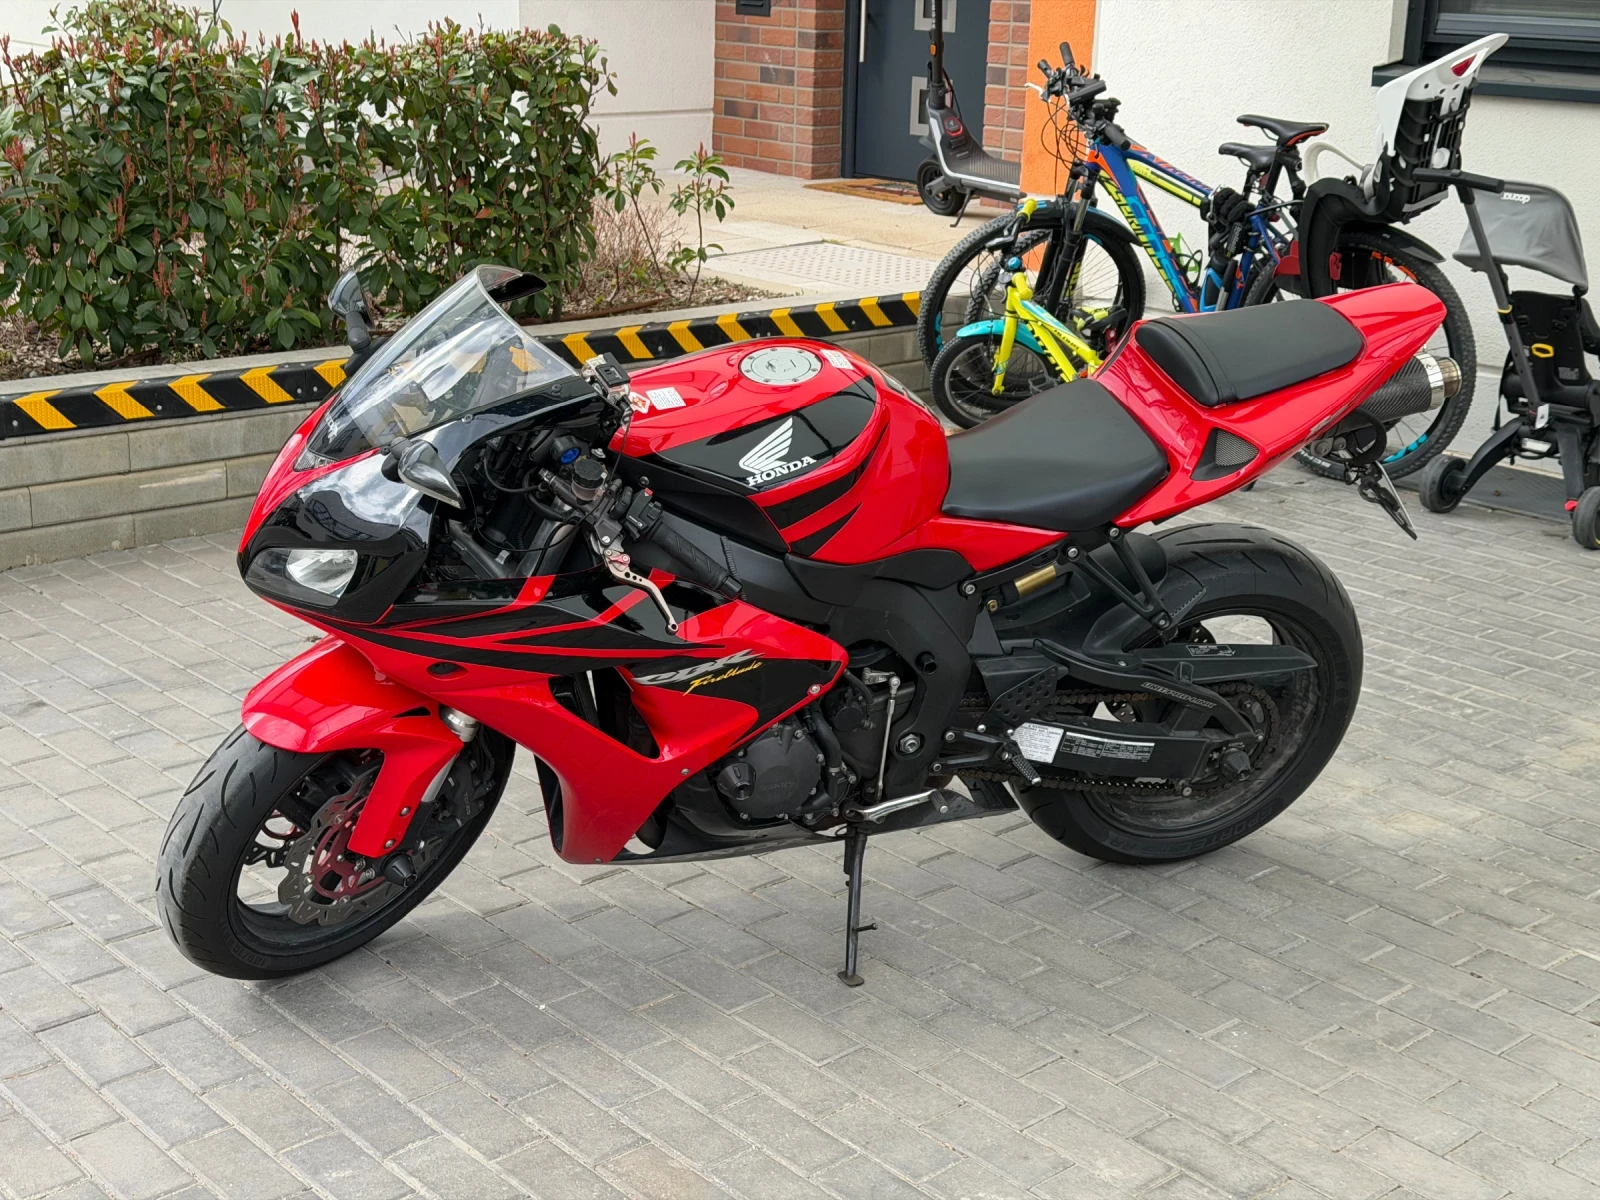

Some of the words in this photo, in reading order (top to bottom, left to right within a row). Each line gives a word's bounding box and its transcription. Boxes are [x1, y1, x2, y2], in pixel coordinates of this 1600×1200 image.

[1126, 195, 1187, 298] CROSS
[746, 455, 817, 487] HONDA
[682, 660, 763, 697] Fireblade
